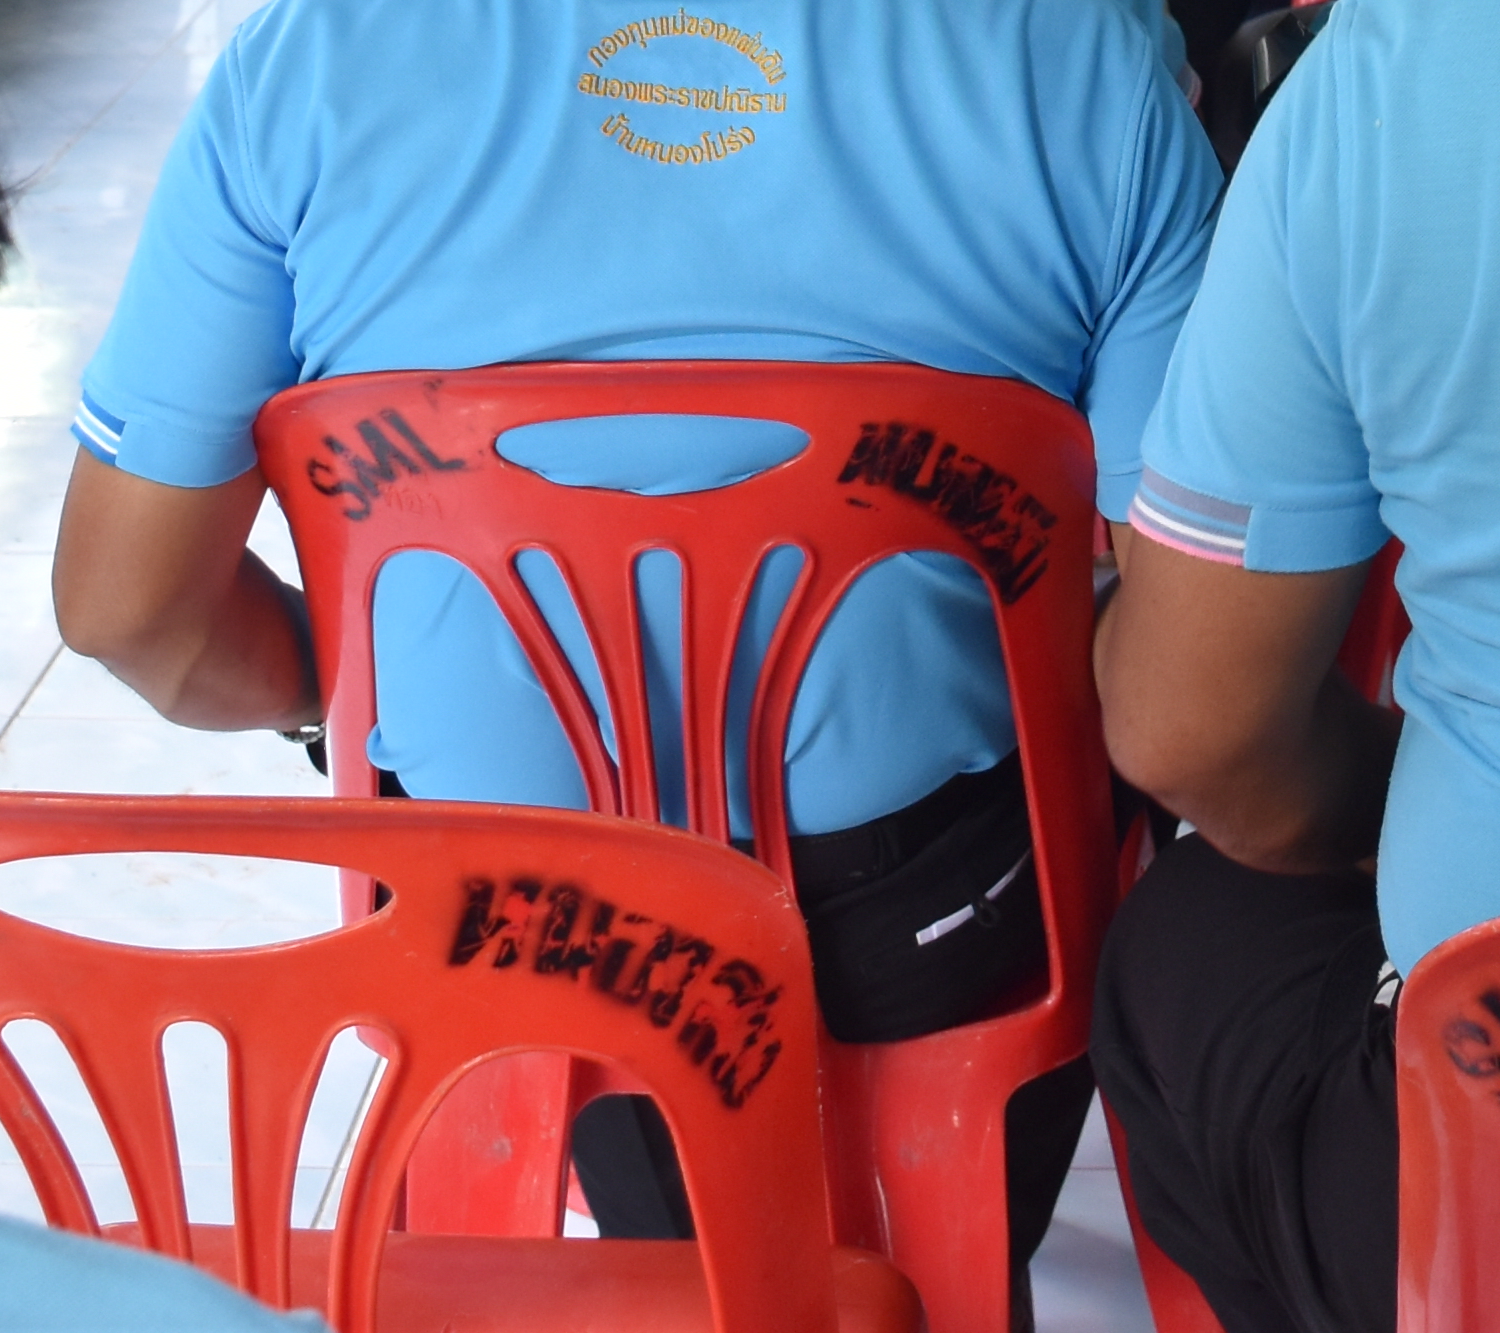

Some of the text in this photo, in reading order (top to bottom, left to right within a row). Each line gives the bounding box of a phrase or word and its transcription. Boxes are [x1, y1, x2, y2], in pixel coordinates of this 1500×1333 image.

[587, 7, 787, 85] กองทุนแม่ของแผ่นดิน
[305, 407, 470, 523] SML
